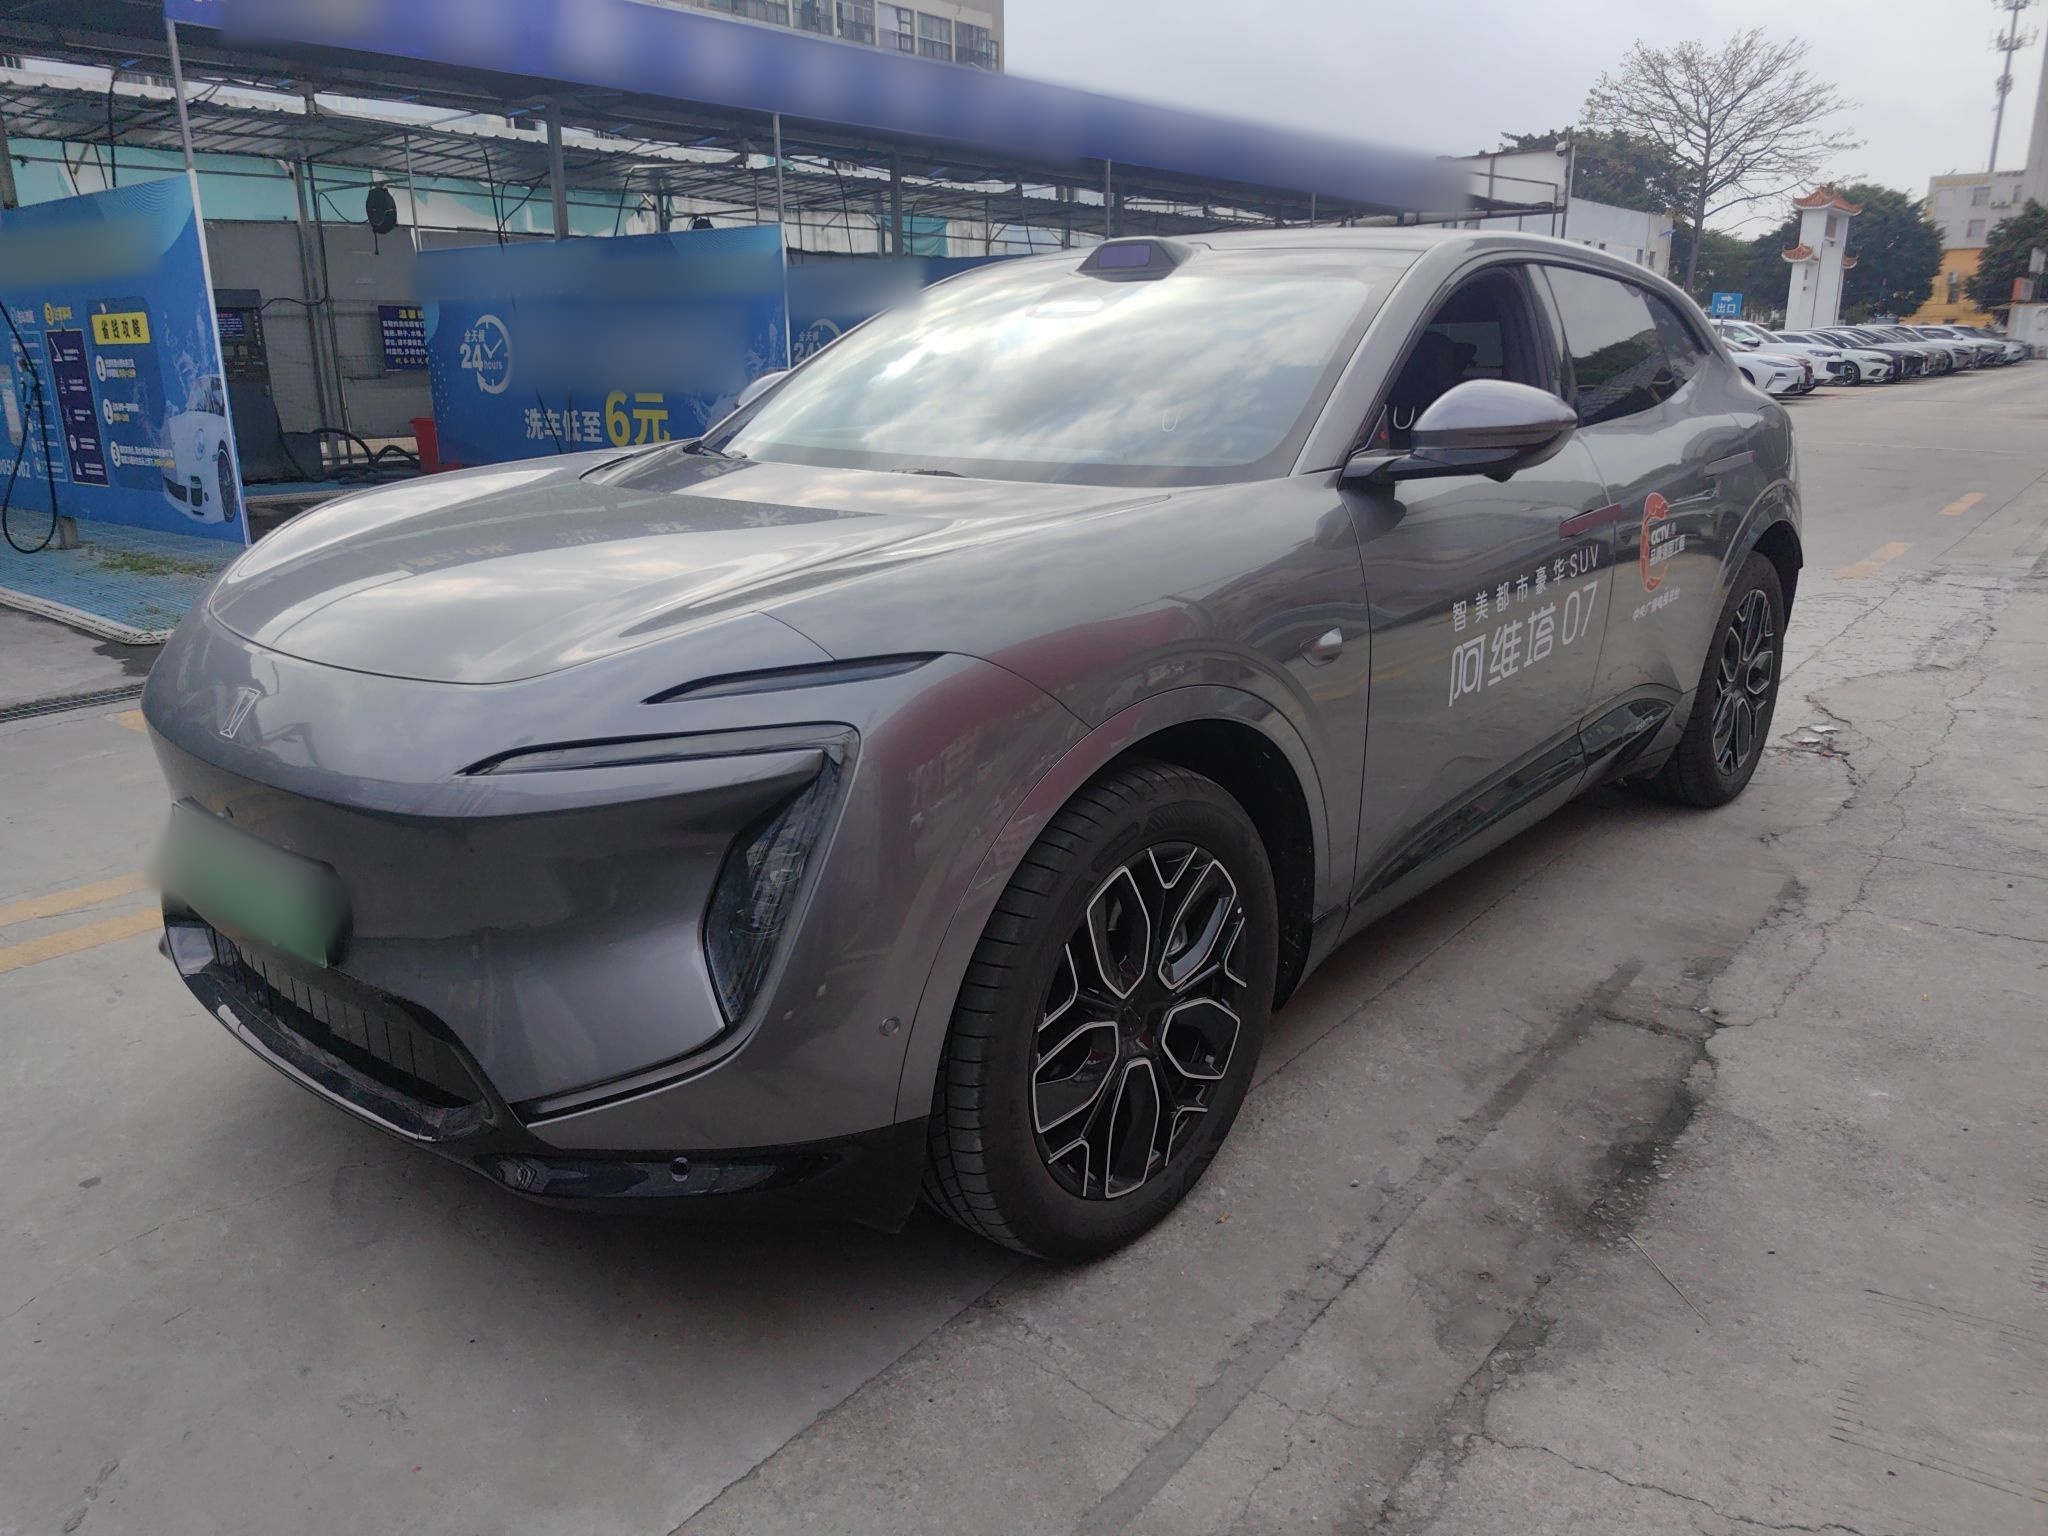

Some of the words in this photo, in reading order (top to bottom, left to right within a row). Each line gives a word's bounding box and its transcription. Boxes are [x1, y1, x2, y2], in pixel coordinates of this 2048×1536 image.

[1717, 303, 1736, 313] 出口
[460, 343, 483, 371] 24
[484, 359, 503, 370] hours
[1651, 523, 1670, 545] CCTV
